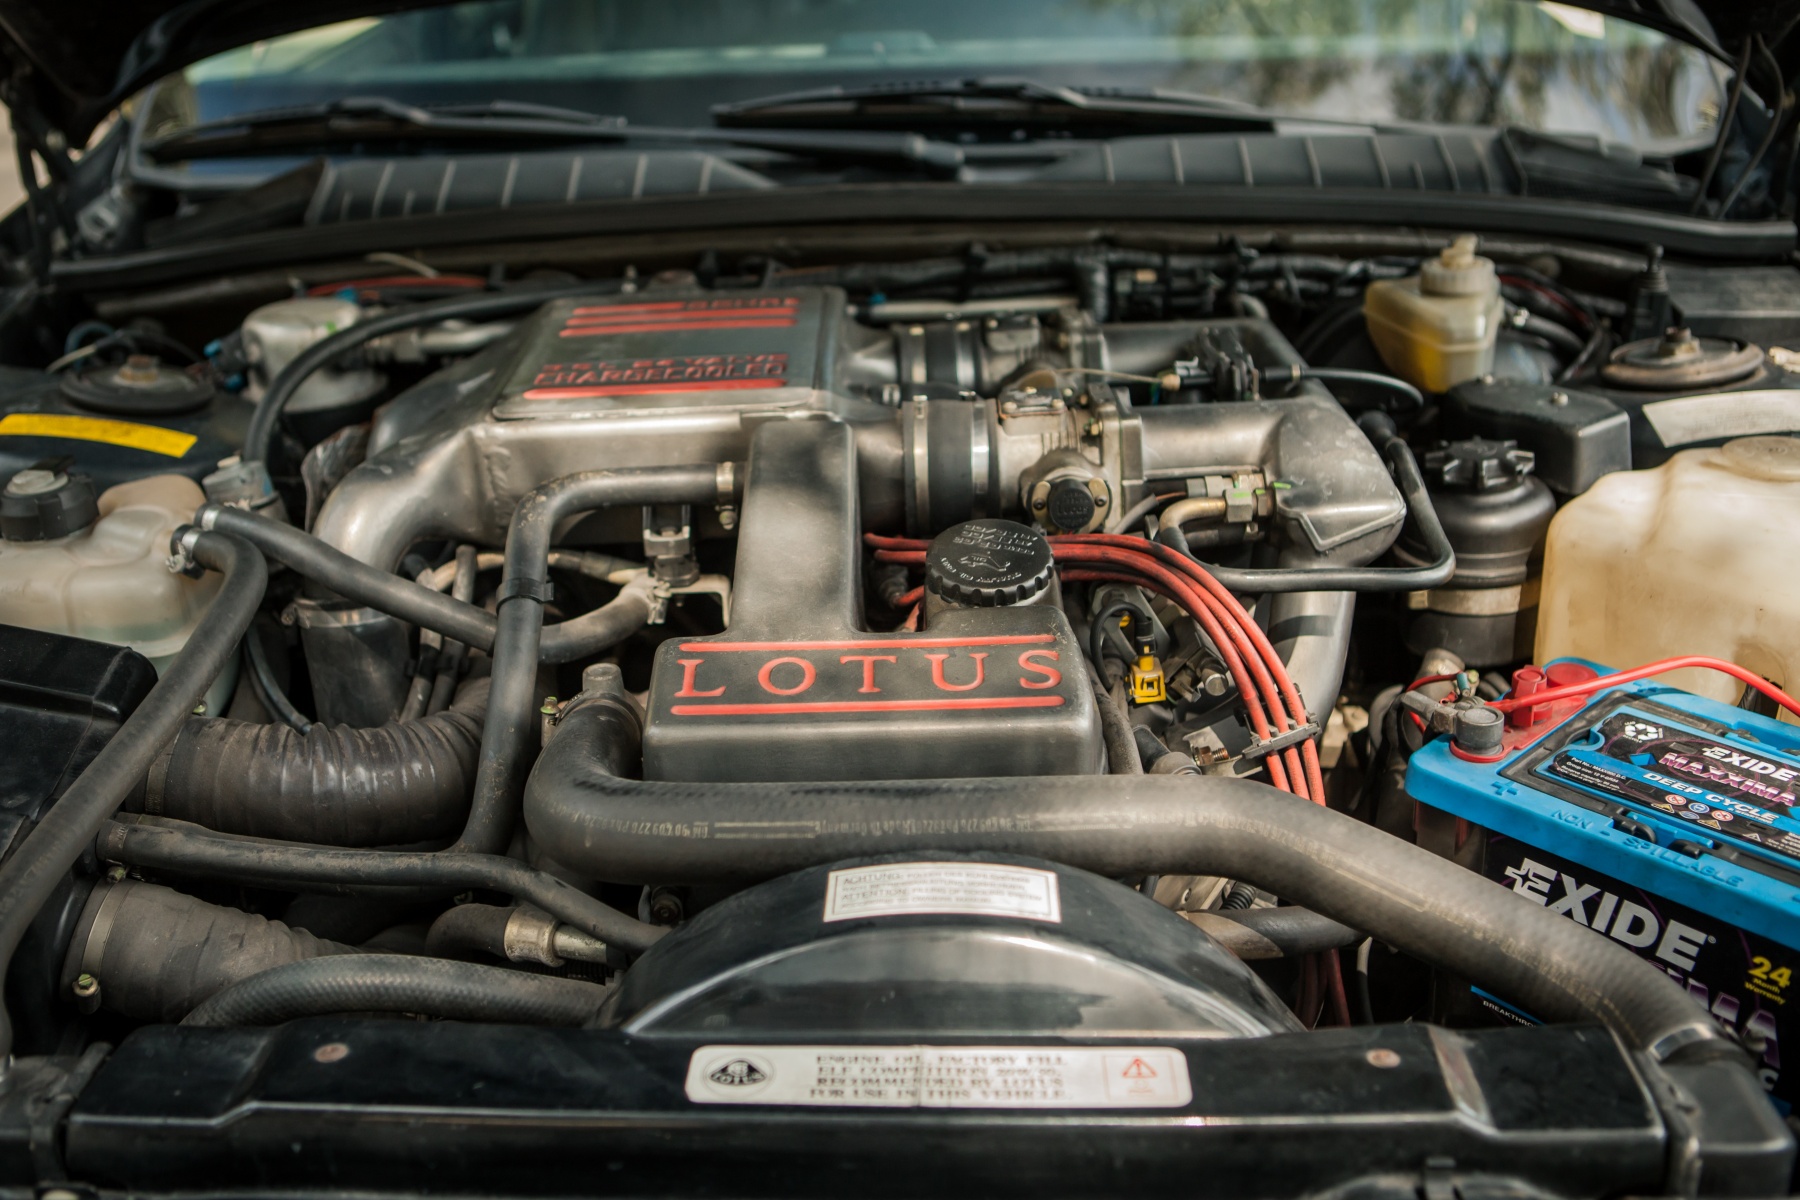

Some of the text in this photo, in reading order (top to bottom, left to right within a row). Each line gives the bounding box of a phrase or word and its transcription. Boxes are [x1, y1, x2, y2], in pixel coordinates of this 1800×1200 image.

[533, 362, 788, 385] CHARGECOOLED
[674, 650, 1062, 698] LOTUS
[1702, 746, 1799, 781] EXIDE
[1659, 752, 1796, 807] MAXXIMA
[1643, 773, 1703, 794] DEEP
[1705, 794, 1780, 819] CYCLE
[1552, 809, 1594, 830] NON
[1504, 857, 1708, 972] EXIDE
[1748, 956, 1792, 988] 24
[1744, 982, 1786, 1005] Warranty
[1753, 978, 1780, 994] Month
[817, 1055, 885, 1065] ENGINE
[939, 1055, 1017, 1065] FACTORY
[810, 1088, 845, 1098] FOR
[817, 1077, 964, 1087] RECOMMENDED
